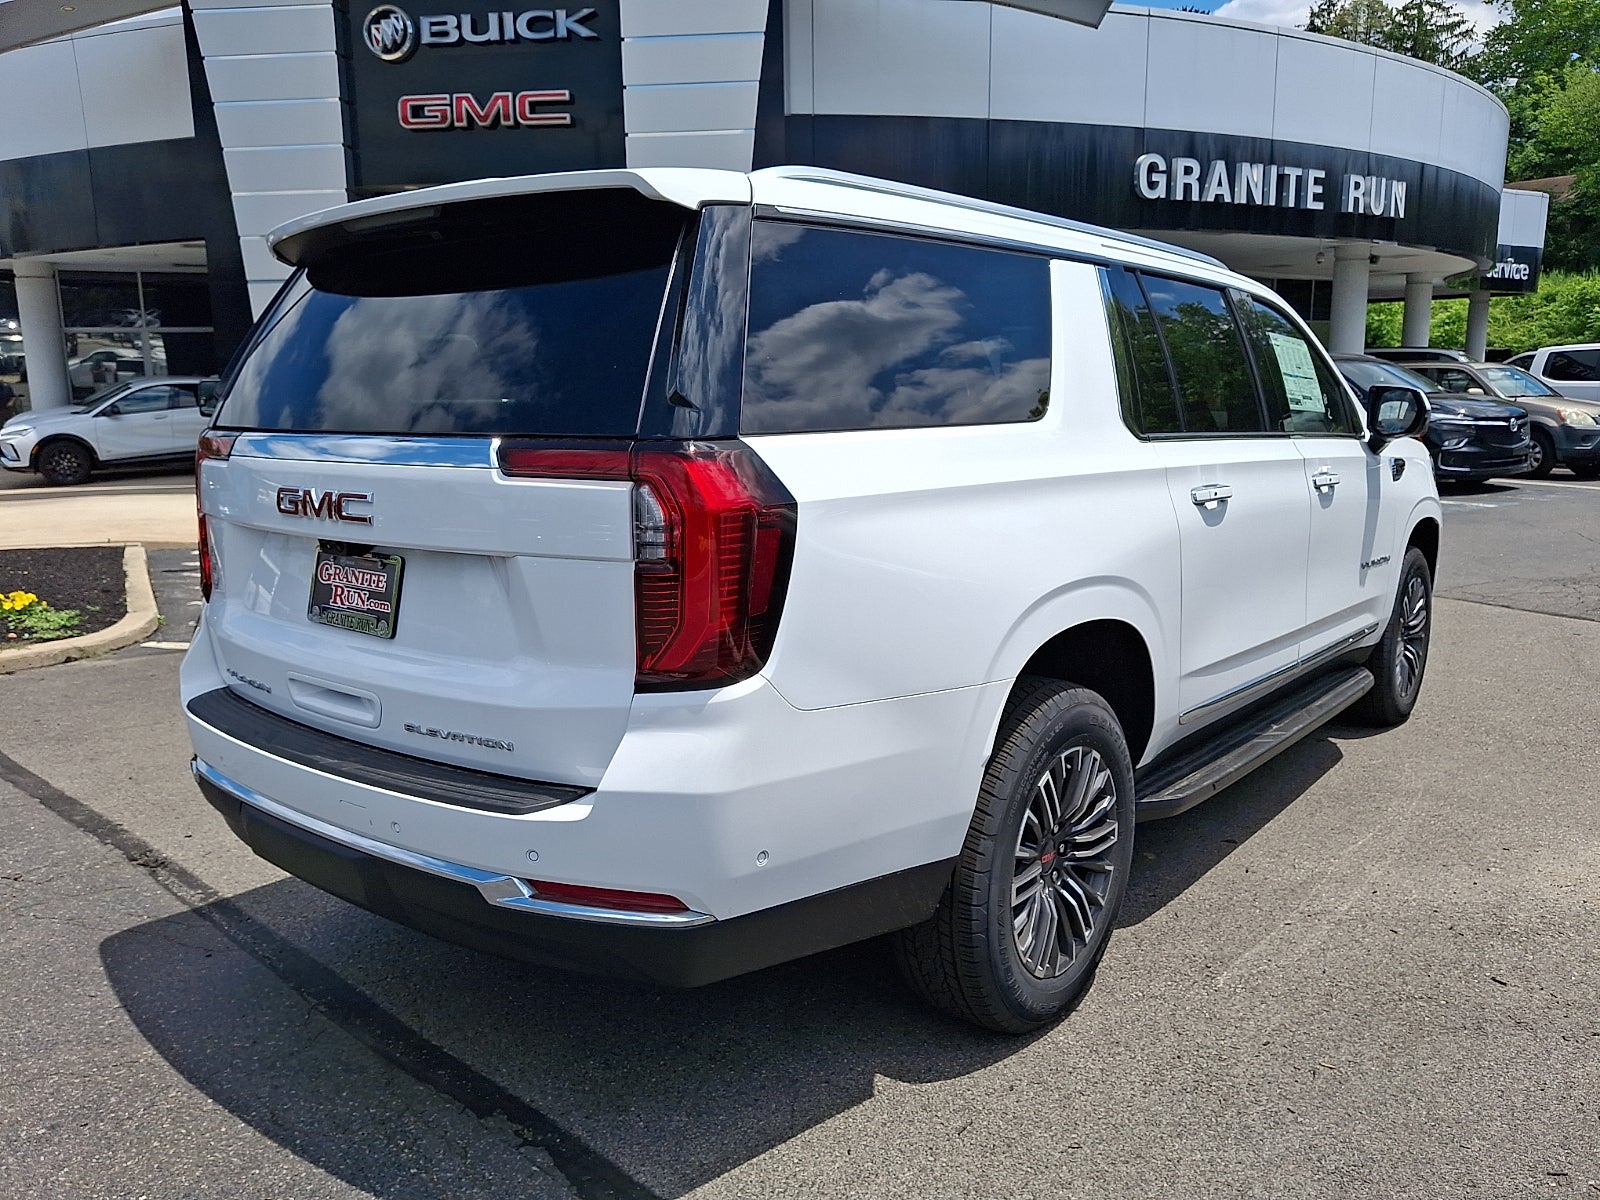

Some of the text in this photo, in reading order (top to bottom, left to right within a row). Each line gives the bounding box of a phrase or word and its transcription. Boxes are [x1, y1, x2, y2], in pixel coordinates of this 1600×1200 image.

[419, 8, 599, 45] BUICK
[398, 89, 571, 129] GMC
[1134, 153, 1407, 219] GRANITE RUN
[276, 486, 375, 527] GMC
[317, 560, 388, 593] GRANITE
[330, 583, 391, 613] RUN.com
[402, 721, 515, 752] ELEVATION
